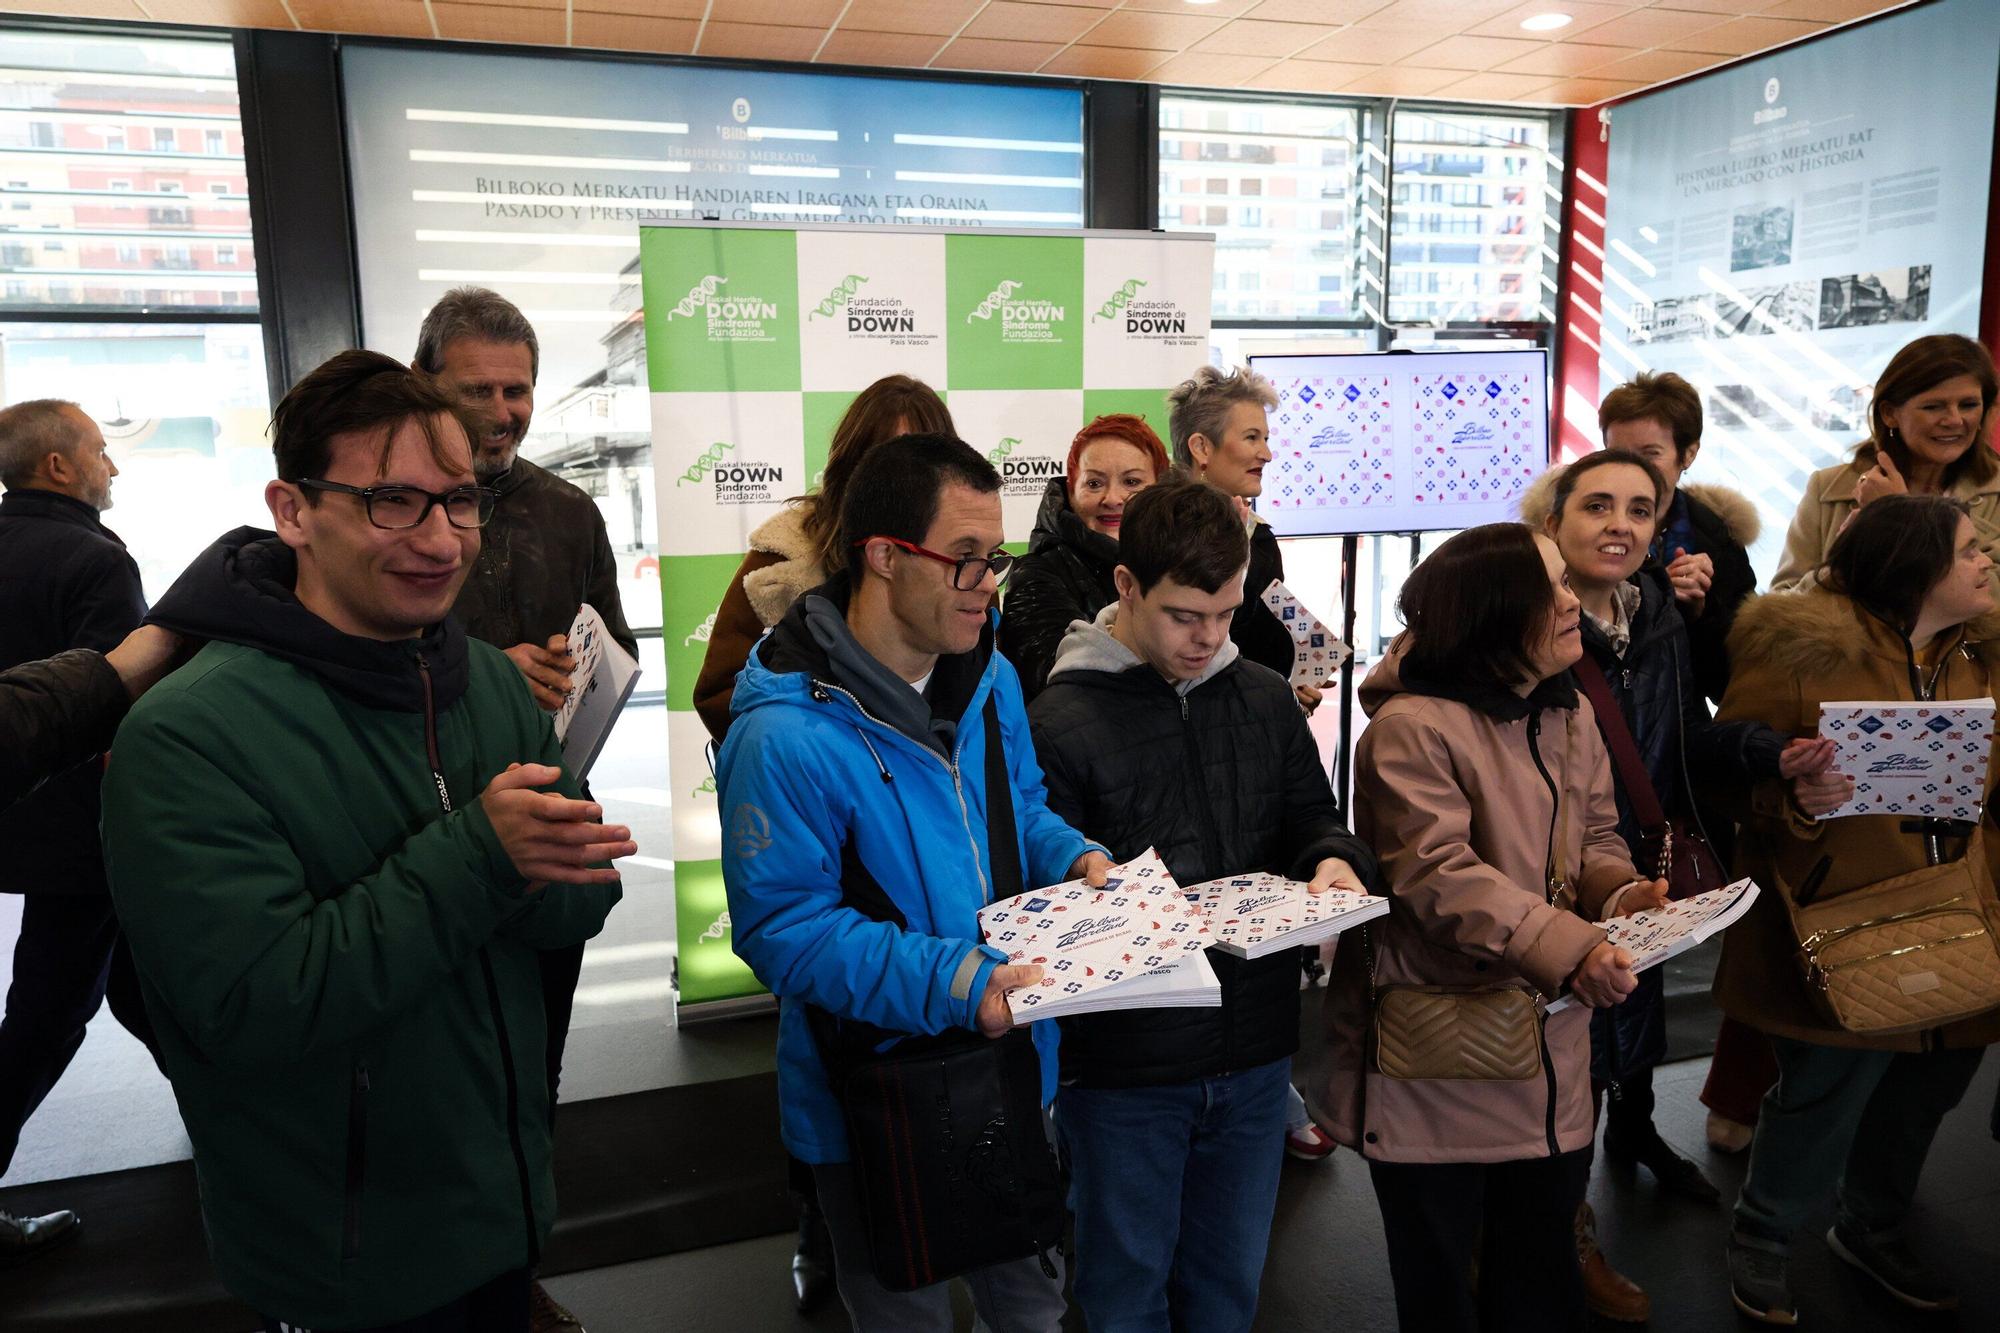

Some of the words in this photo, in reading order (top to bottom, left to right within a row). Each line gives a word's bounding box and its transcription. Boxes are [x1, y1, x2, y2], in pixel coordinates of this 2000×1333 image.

[1675, 163, 1728, 186] HISTORIA
[1731, 151, 1778, 173] LUZEKO
[1780, 135, 1845, 161] MERKATU
[1847, 128, 1876, 146] BAT
[1703, 169, 1766, 193] MERCADO
[1766, 162, 1796, 181] CON
[1799, 148, 1866, 173] HISTORIA
[476, 177, 565, 196] BILBOKO
[572, 181, 667, 200] MERKATU
[675, 184, 790, 204] HANDIAREN
[798, 189, 878, 208] IRAGANA
[884, 194, 914, 209] ETA
[920, 194, 989, 211] ORAINA
[484, 200, 564, 219] PASADO
[570, 204, 583, 220] Y
[847, 297, 903, 307] Fundación
[1126, 300, 1176, 309] Fundación
[706, 303, 777, 319] DOWN
[847, 307, 898, 316] Síndrome
[901, 308, 915, 316] de
[1002, 305, 1065, 321] DOWN
[1126, 309, 1172, 318] Síndrome
[1174, 310, 1187, 318] de
[848, 317, 914, 332] DOWN
[1126, 319, 1185, 333] DOWN
[708, 328, 766, 337] Fundazioa
[1002, 329, 1053, 338] Fundazioa
[714, 467, 783, 483] DOWN
[1003, 461, 1063, 476] DOWN
[715, 483, 768, 492] Sindrome
[716, 492, 771, 501] Fundazioa
[1071, 915, 1122, 934] Bilbao
